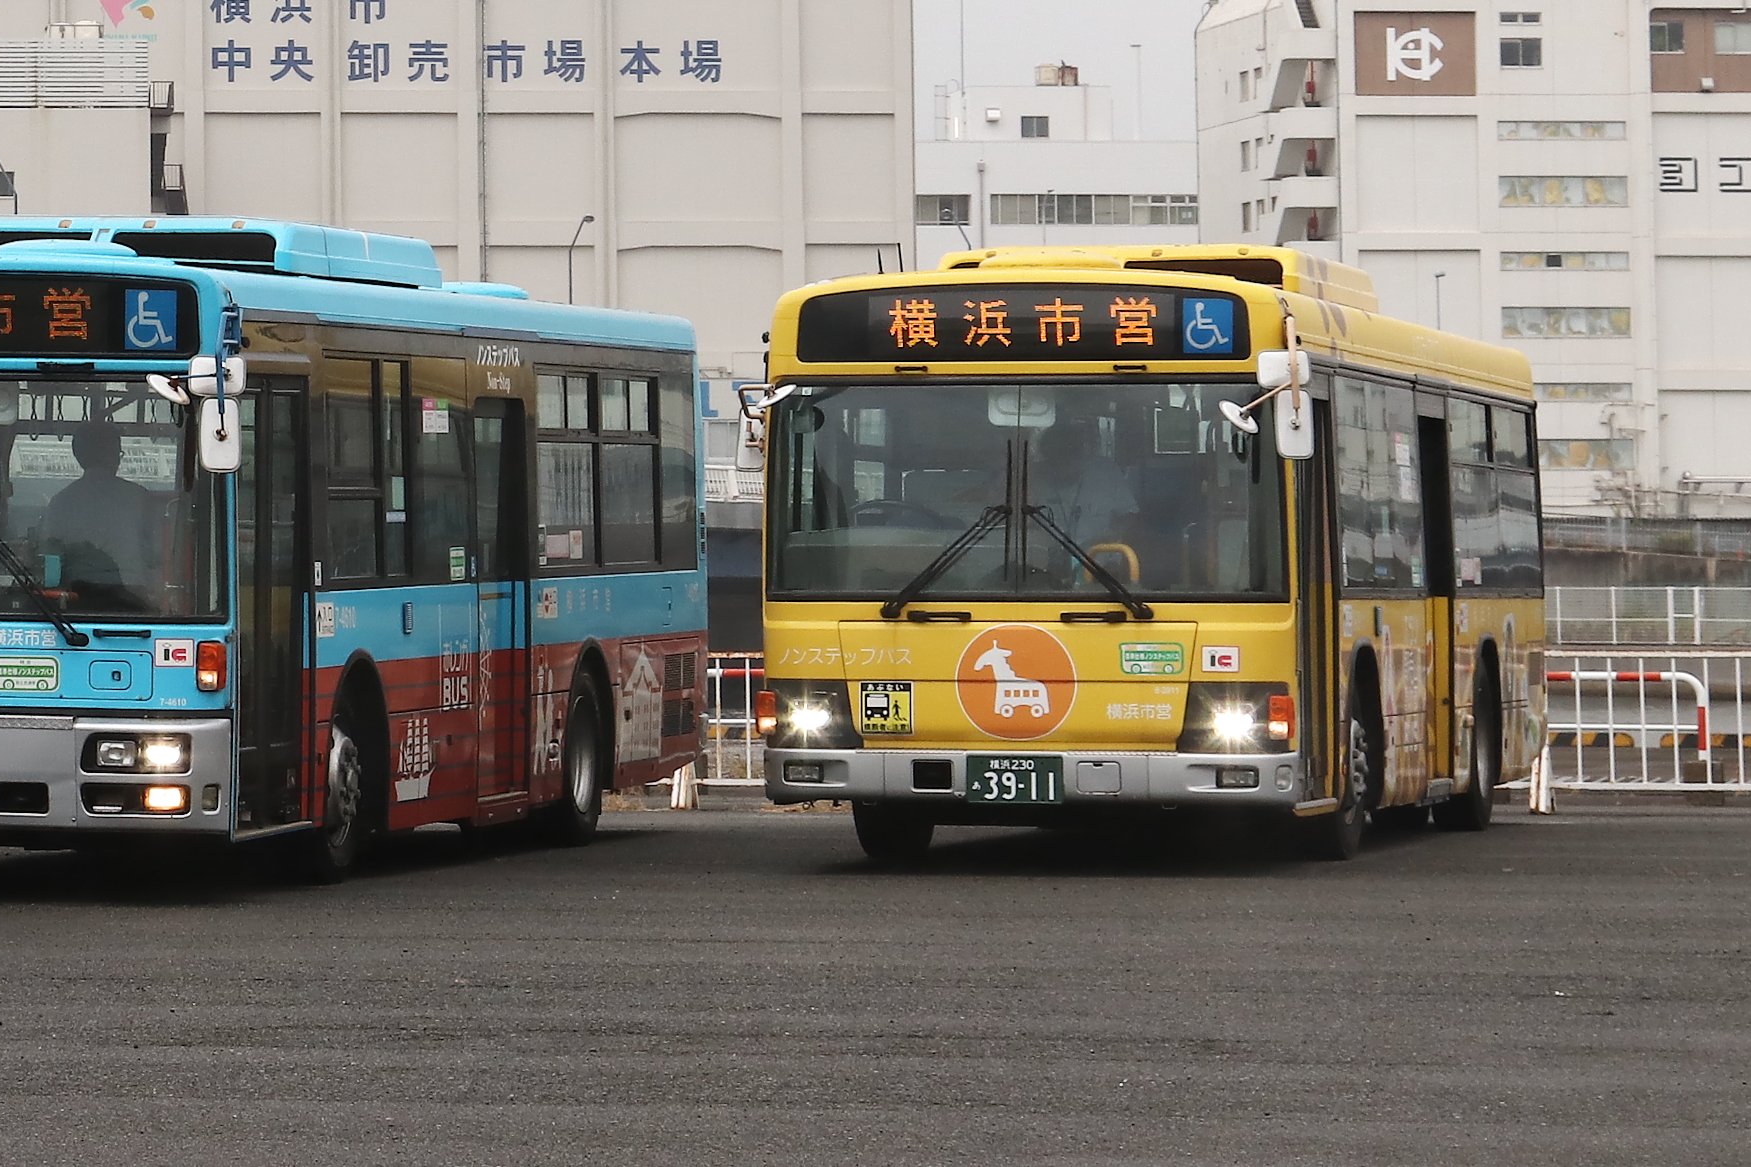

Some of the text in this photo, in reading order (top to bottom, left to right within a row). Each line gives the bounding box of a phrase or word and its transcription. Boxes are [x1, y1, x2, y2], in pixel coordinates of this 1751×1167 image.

[211, 39, 723, 83] 中央卸売市場本場
[889, 297, 1157, 346] 横浜市営
[477, 345, 520, 367] ノンステップバス
[778, 647, 912, 665] ノンステップバス
[443, 676, 469, 710] BUS
[1106, 703, 1172, 720] 横浜市営
[983, 771, 1055, 801] 39-11
